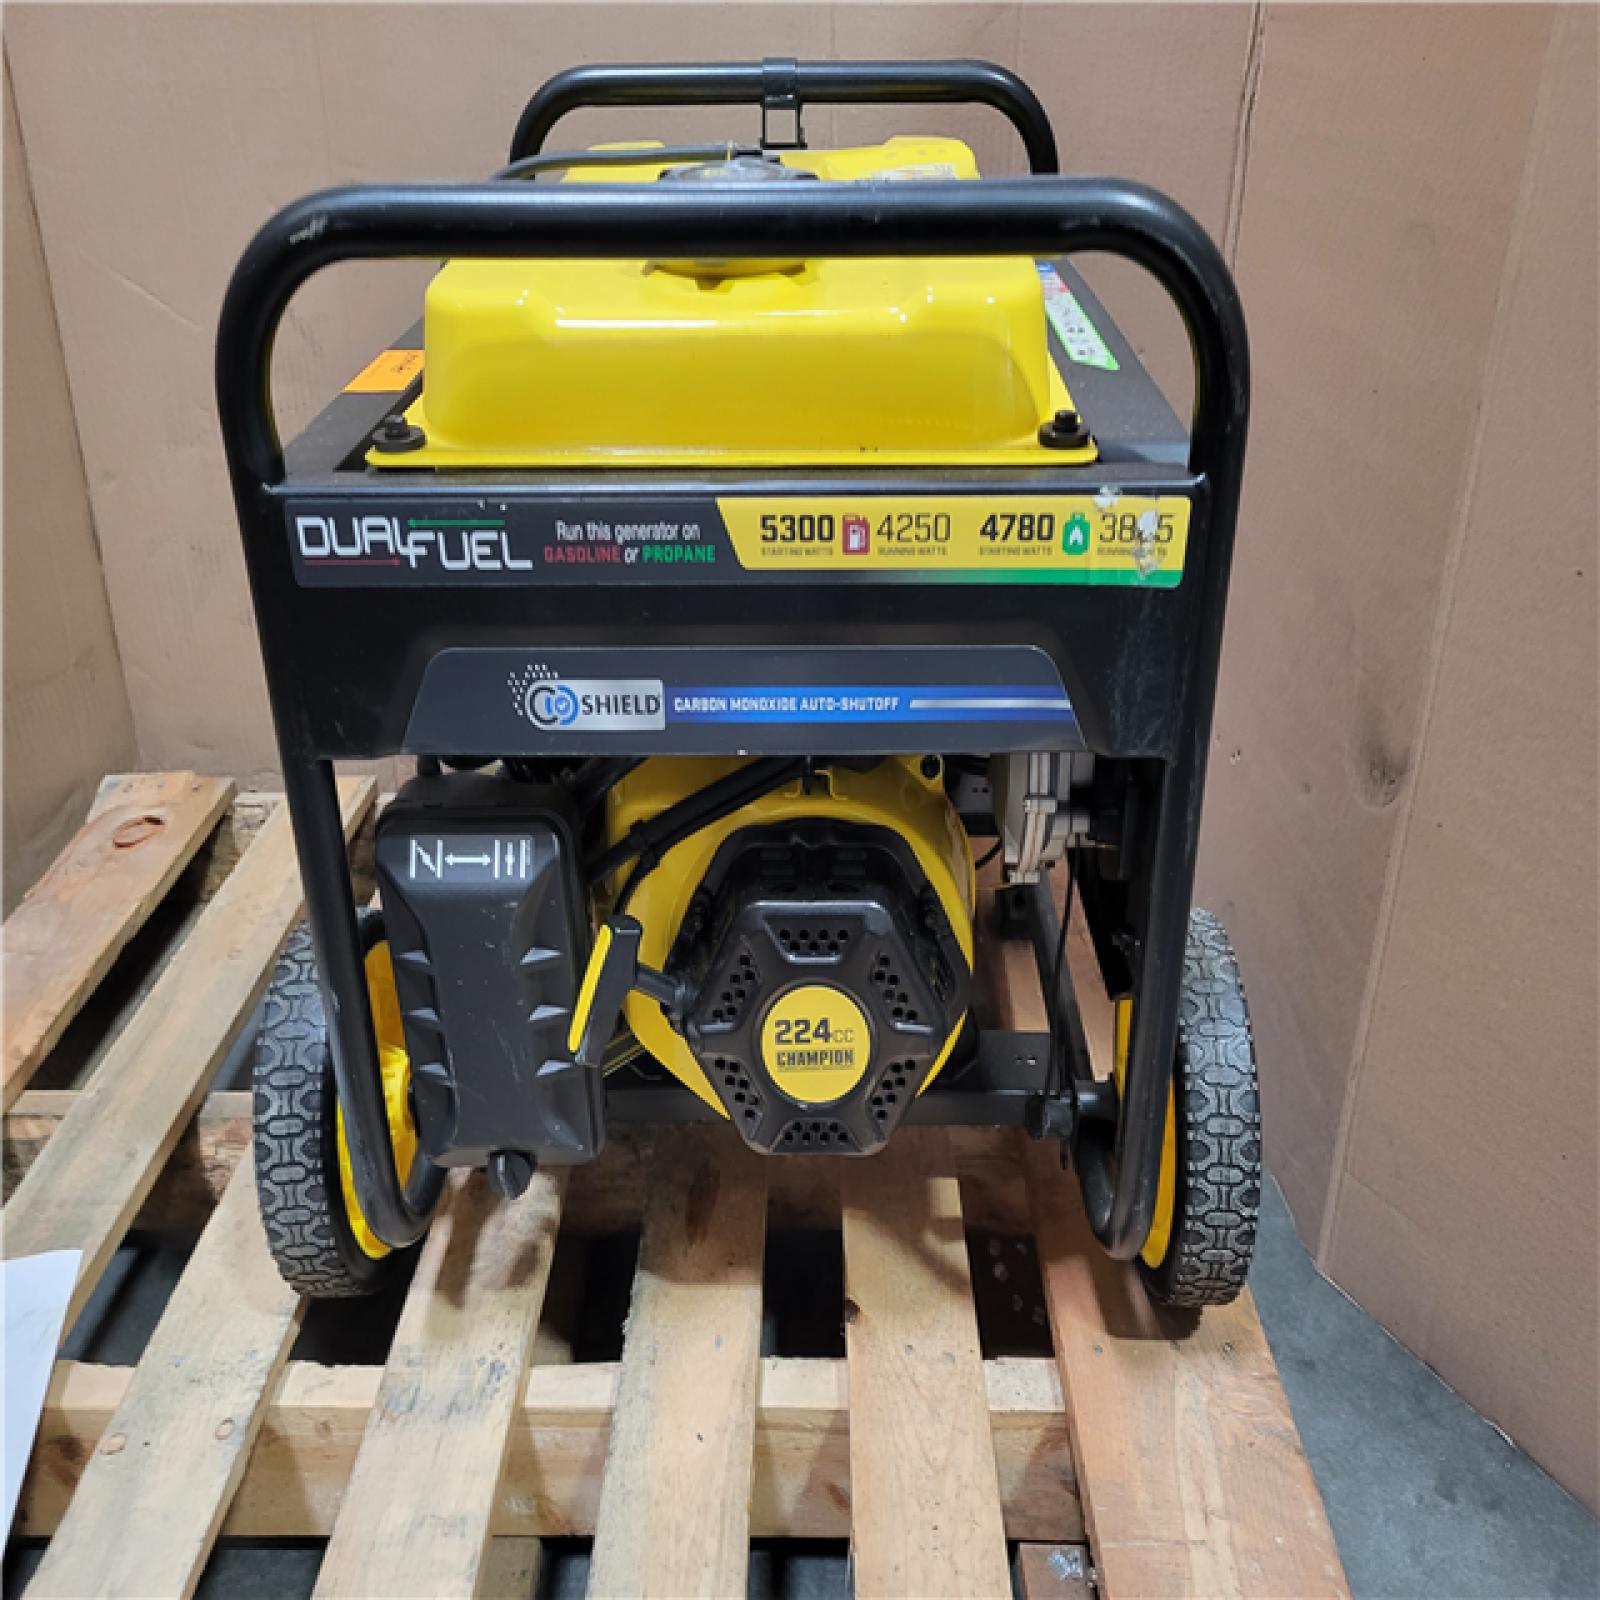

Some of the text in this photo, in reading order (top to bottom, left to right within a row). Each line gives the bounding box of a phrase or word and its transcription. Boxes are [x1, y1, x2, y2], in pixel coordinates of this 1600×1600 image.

[555, 519, 700, 546] Run this generator on
[760, 513, 835, 542] 5300
[876, 513, 951, 542] 4250
[979, 513, 1055, 542] 4780
[1099, 512, 1175, 543] 385
[295, 515, 533, 570] DUAL FUEL
[543, 544, 716, 564] GASOLINE or PROPANE
[581, 694, 661, 716] SHIELD
[674, 696, 899, 712] CARBON MONOXIDE AUTO-SHUTOFF
[776, 1049, 855, 1068] CHAMPION
